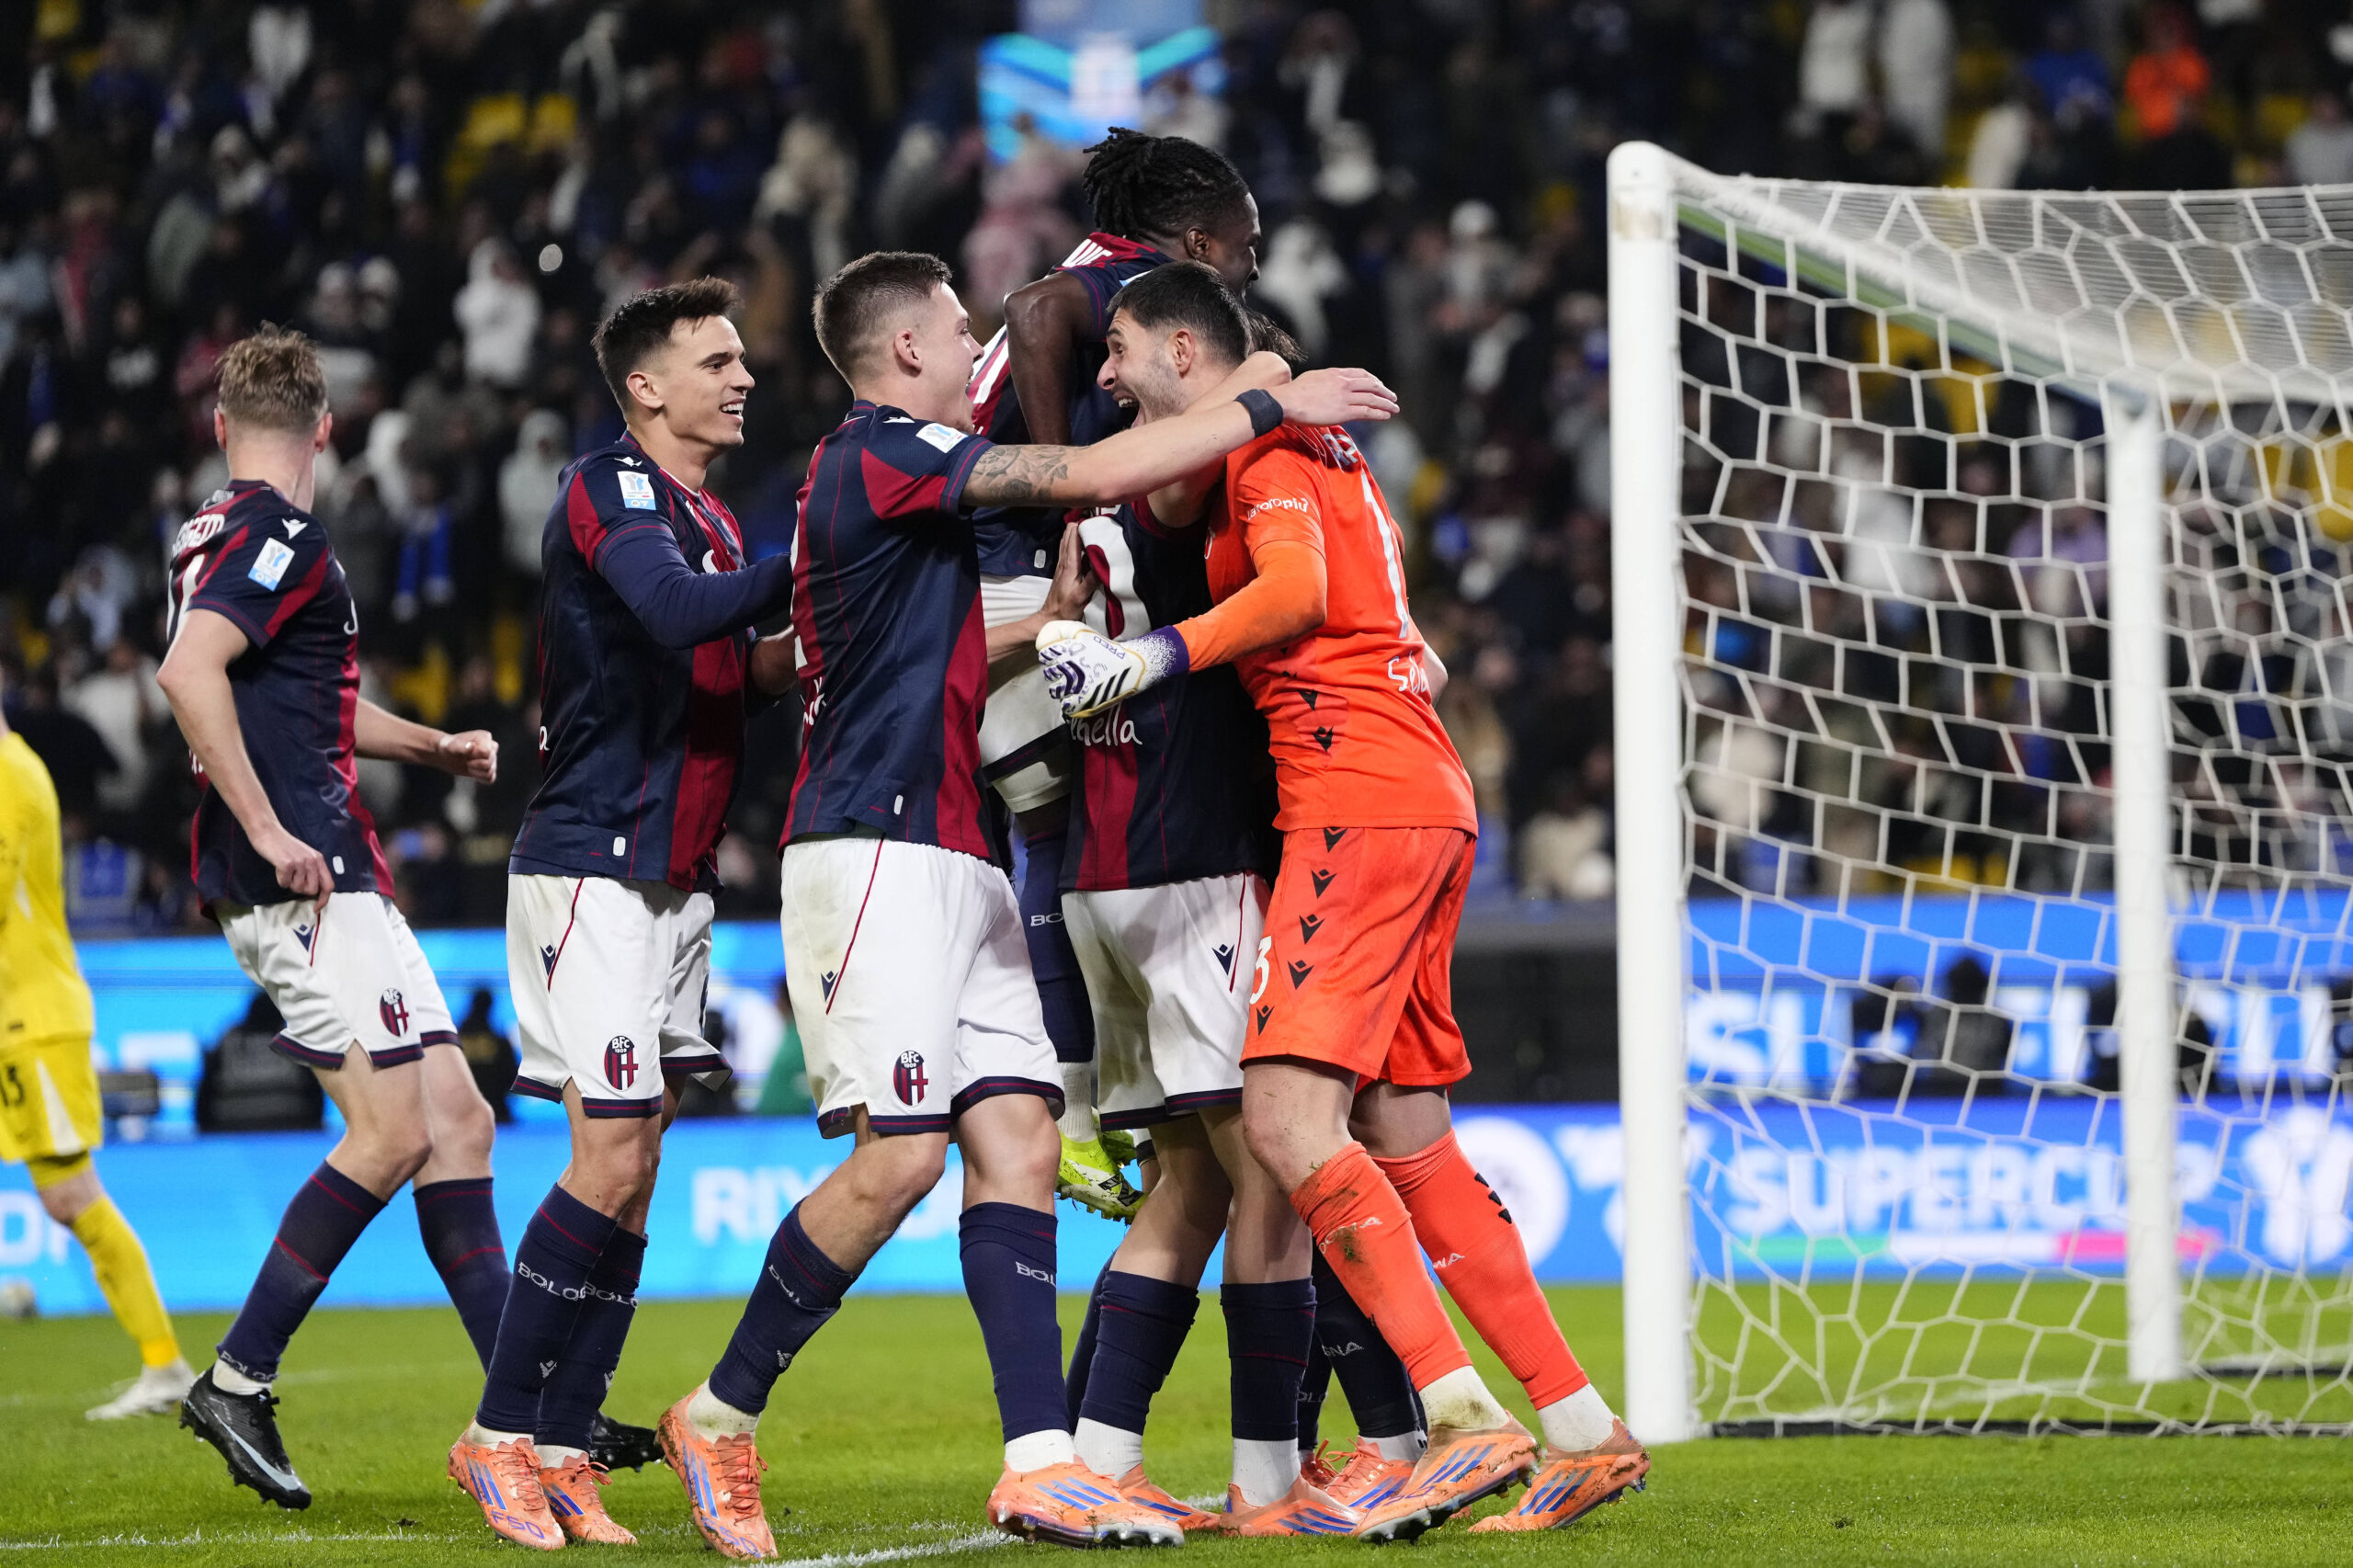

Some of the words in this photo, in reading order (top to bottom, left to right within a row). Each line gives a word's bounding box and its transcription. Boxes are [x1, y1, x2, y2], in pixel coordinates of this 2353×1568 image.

[611, 1036, 631, 1049] BFC
[901, 1051, 920, 1064] BFC
[491, 1510, 545, 1540] F50
